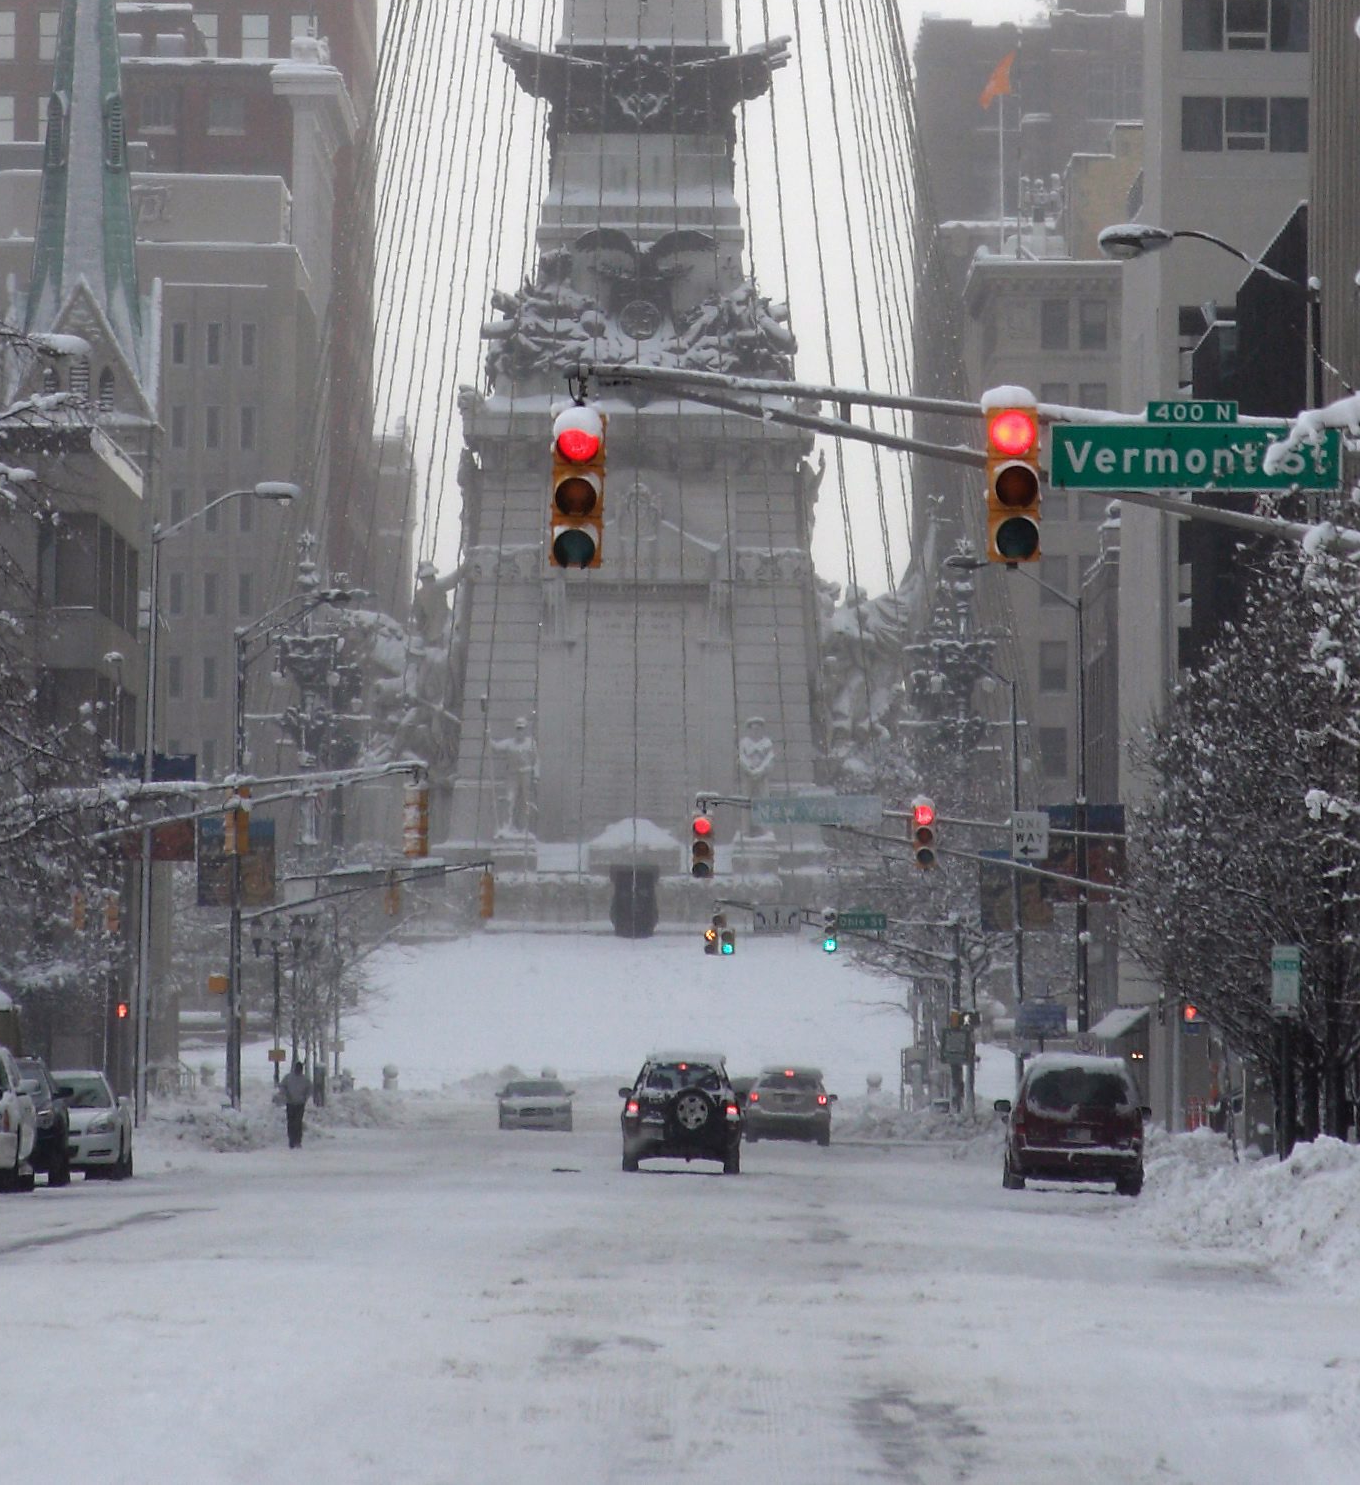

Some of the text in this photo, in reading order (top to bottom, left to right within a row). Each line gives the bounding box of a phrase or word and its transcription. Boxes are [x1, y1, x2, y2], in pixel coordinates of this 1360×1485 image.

[1154, 404, 1231, 421] 400 N
[1064, 441, 1258, 475] Vermont
[1016, 818, 1041, 829] ONE
[1015, 833, 1043, 843] WAY
